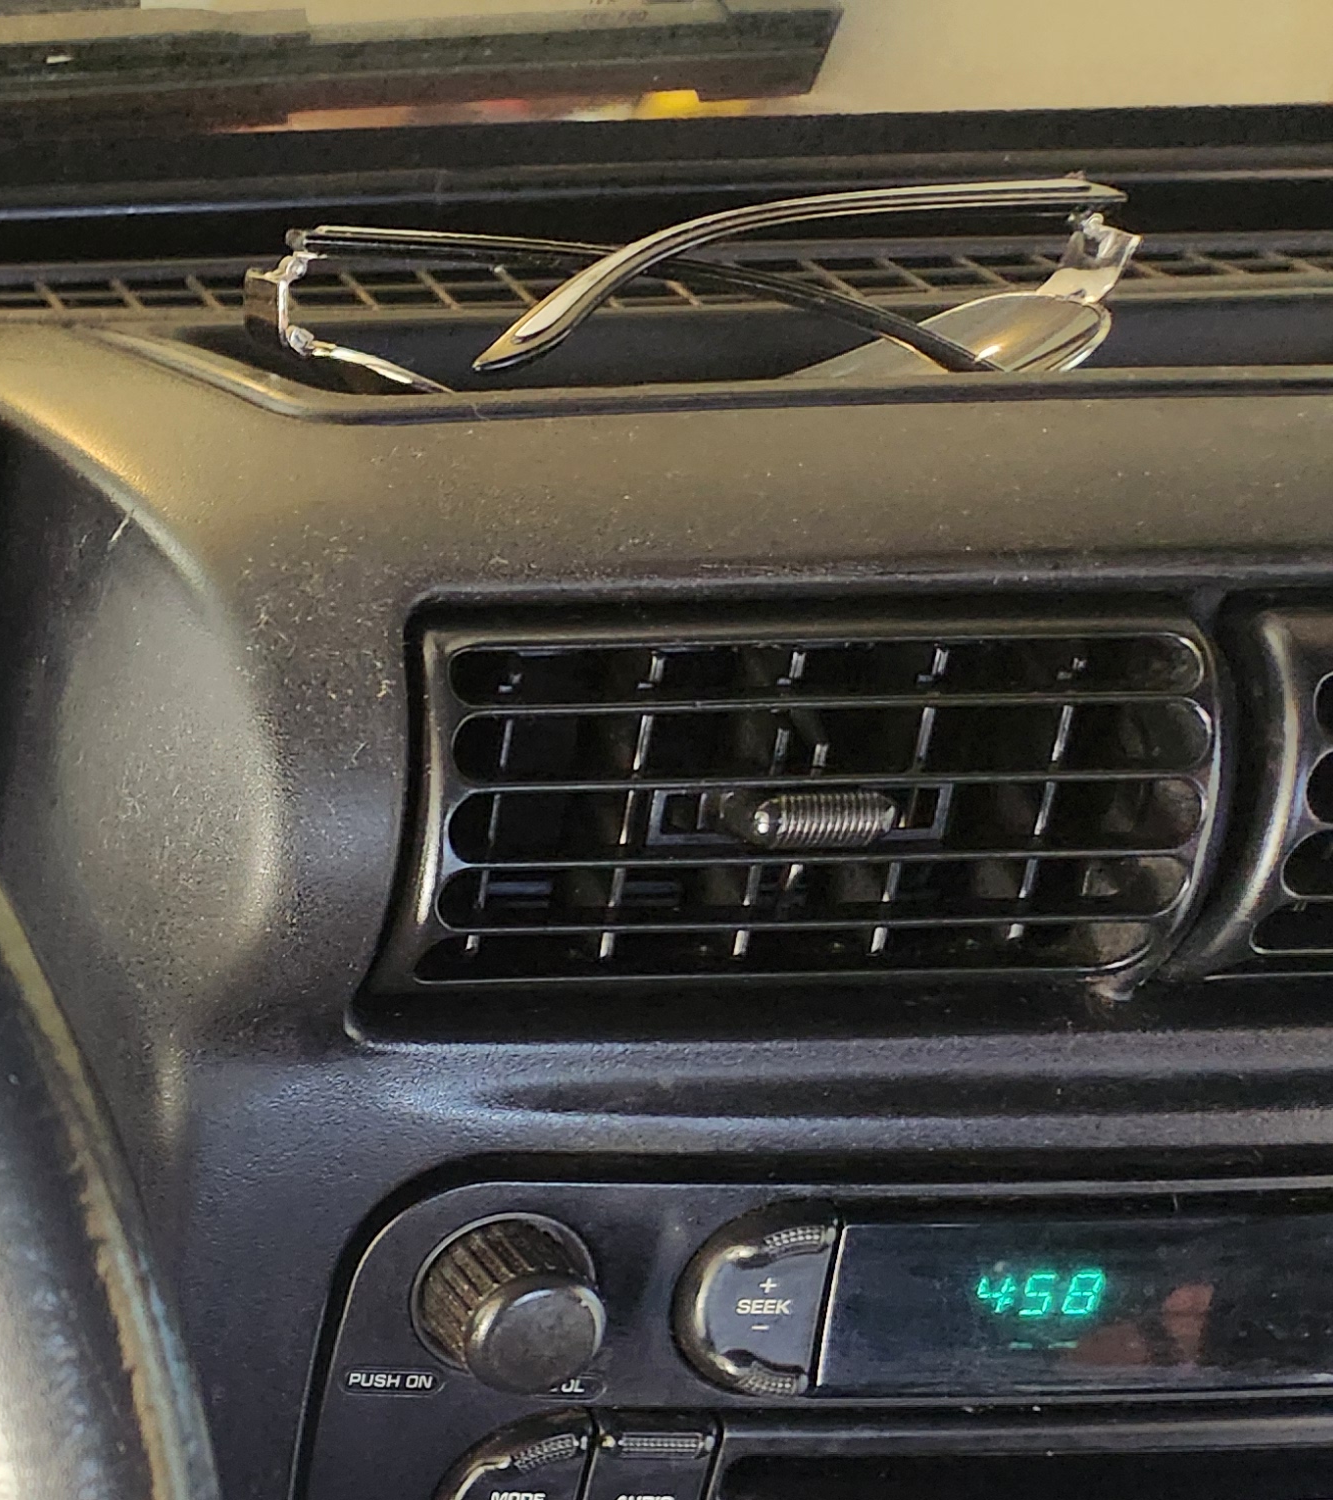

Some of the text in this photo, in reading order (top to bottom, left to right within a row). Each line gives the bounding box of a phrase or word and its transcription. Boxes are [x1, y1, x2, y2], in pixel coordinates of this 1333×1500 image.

[736, 1299, 791, 1316] SEEK
[348, 1373, 433, 1390] PUSH ON
[549, 1378, 585, 1393] OL
